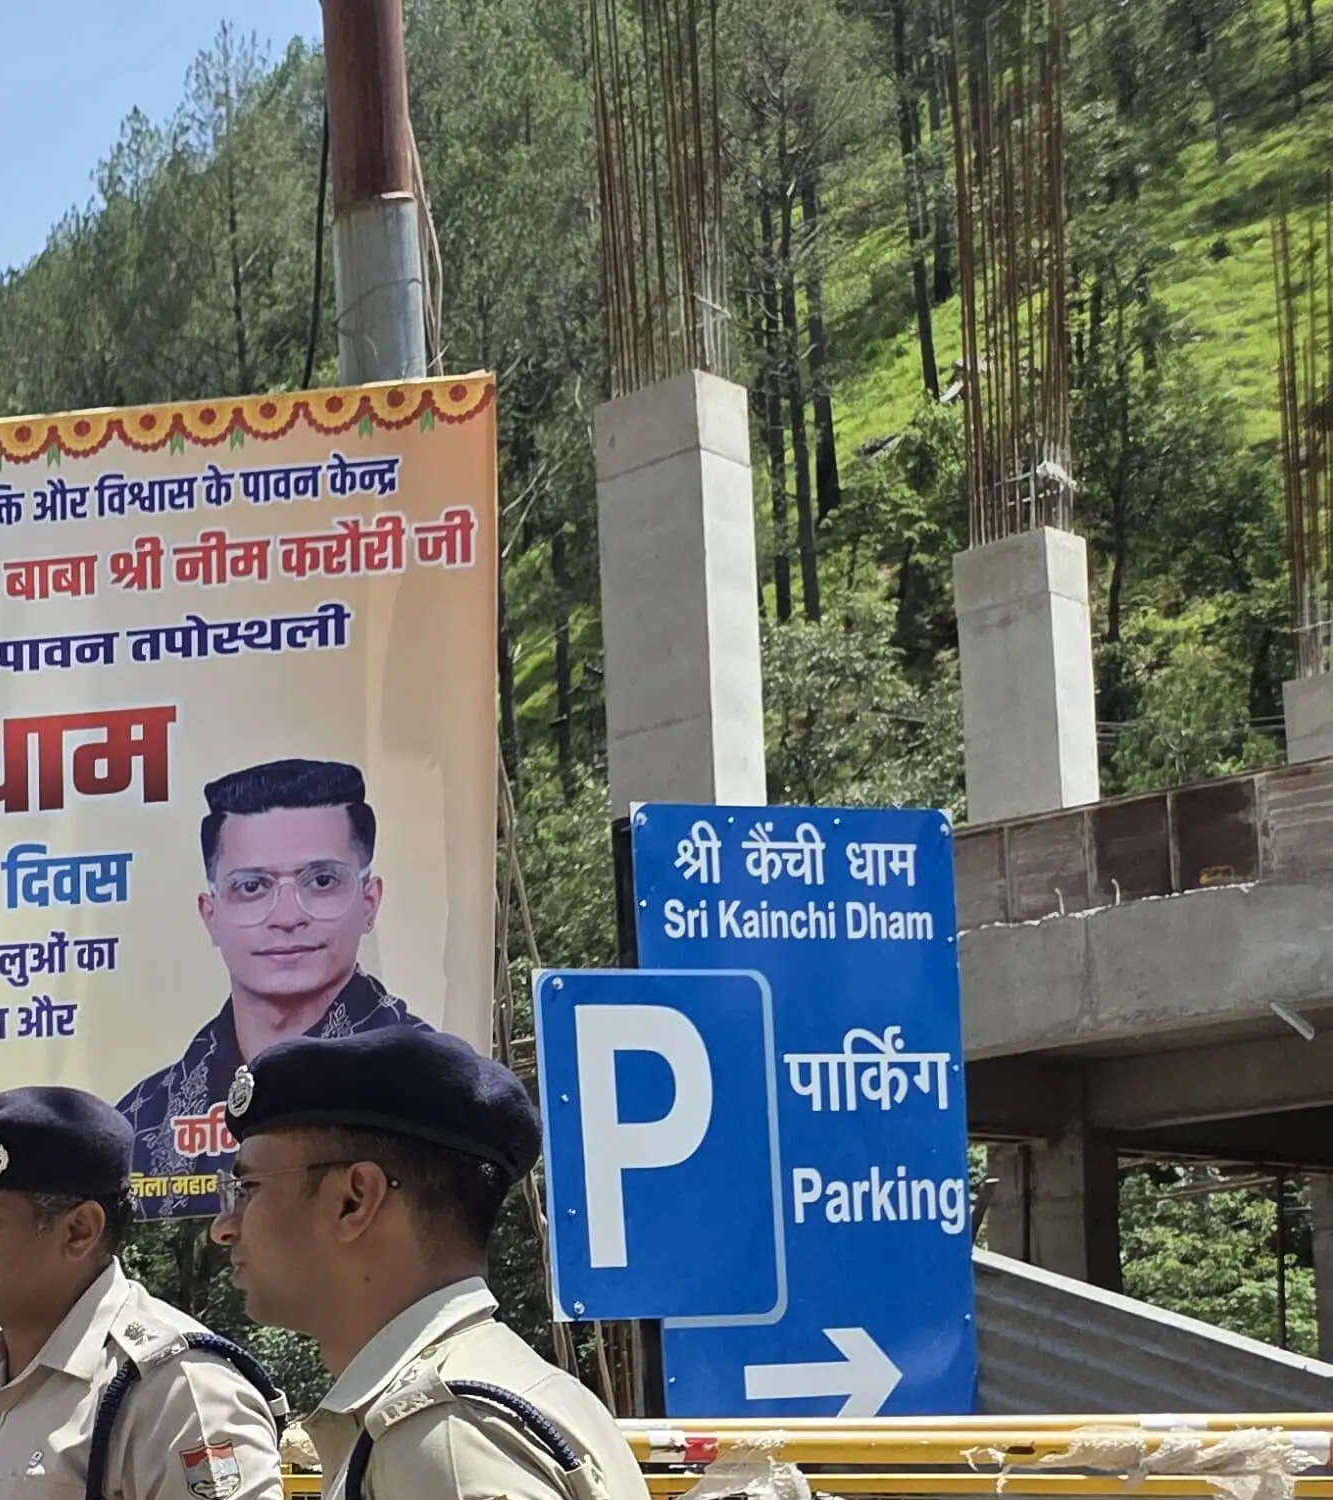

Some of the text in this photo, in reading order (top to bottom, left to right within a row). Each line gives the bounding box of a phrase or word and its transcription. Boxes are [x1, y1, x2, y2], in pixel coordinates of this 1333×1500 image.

[32, 477, 89, 522] और
[96, 472, 197, 517] विश्वास
[205, 464, 235, 507] के
[239, 463, 323, 500] पावन
[327, 453, 401, 497] केन्द्र
[4, 554, 97, 601] बाबा
[109, 536, 164, 592] श्री
[174, 530, 269, 587] नीम
[280, 517, 405, 578] करौरी
[416, 510, 475, 566] जी
[126, 603, 352, 664] तपोस्थली
[1, 843, 133, 910] दिवस
[674, 820, 918, 888] श्री कैंची धाम
[74, 937, 119, 971] का
[664, 900, 934, 940] Sri Kainchi Dham
[17, 994, 78, 1039] और
[783, 1025, 951, 1112] पार्किंग
[574, 1004, 713, 1269] P
[793, 1166, 966, 1235] Parking
